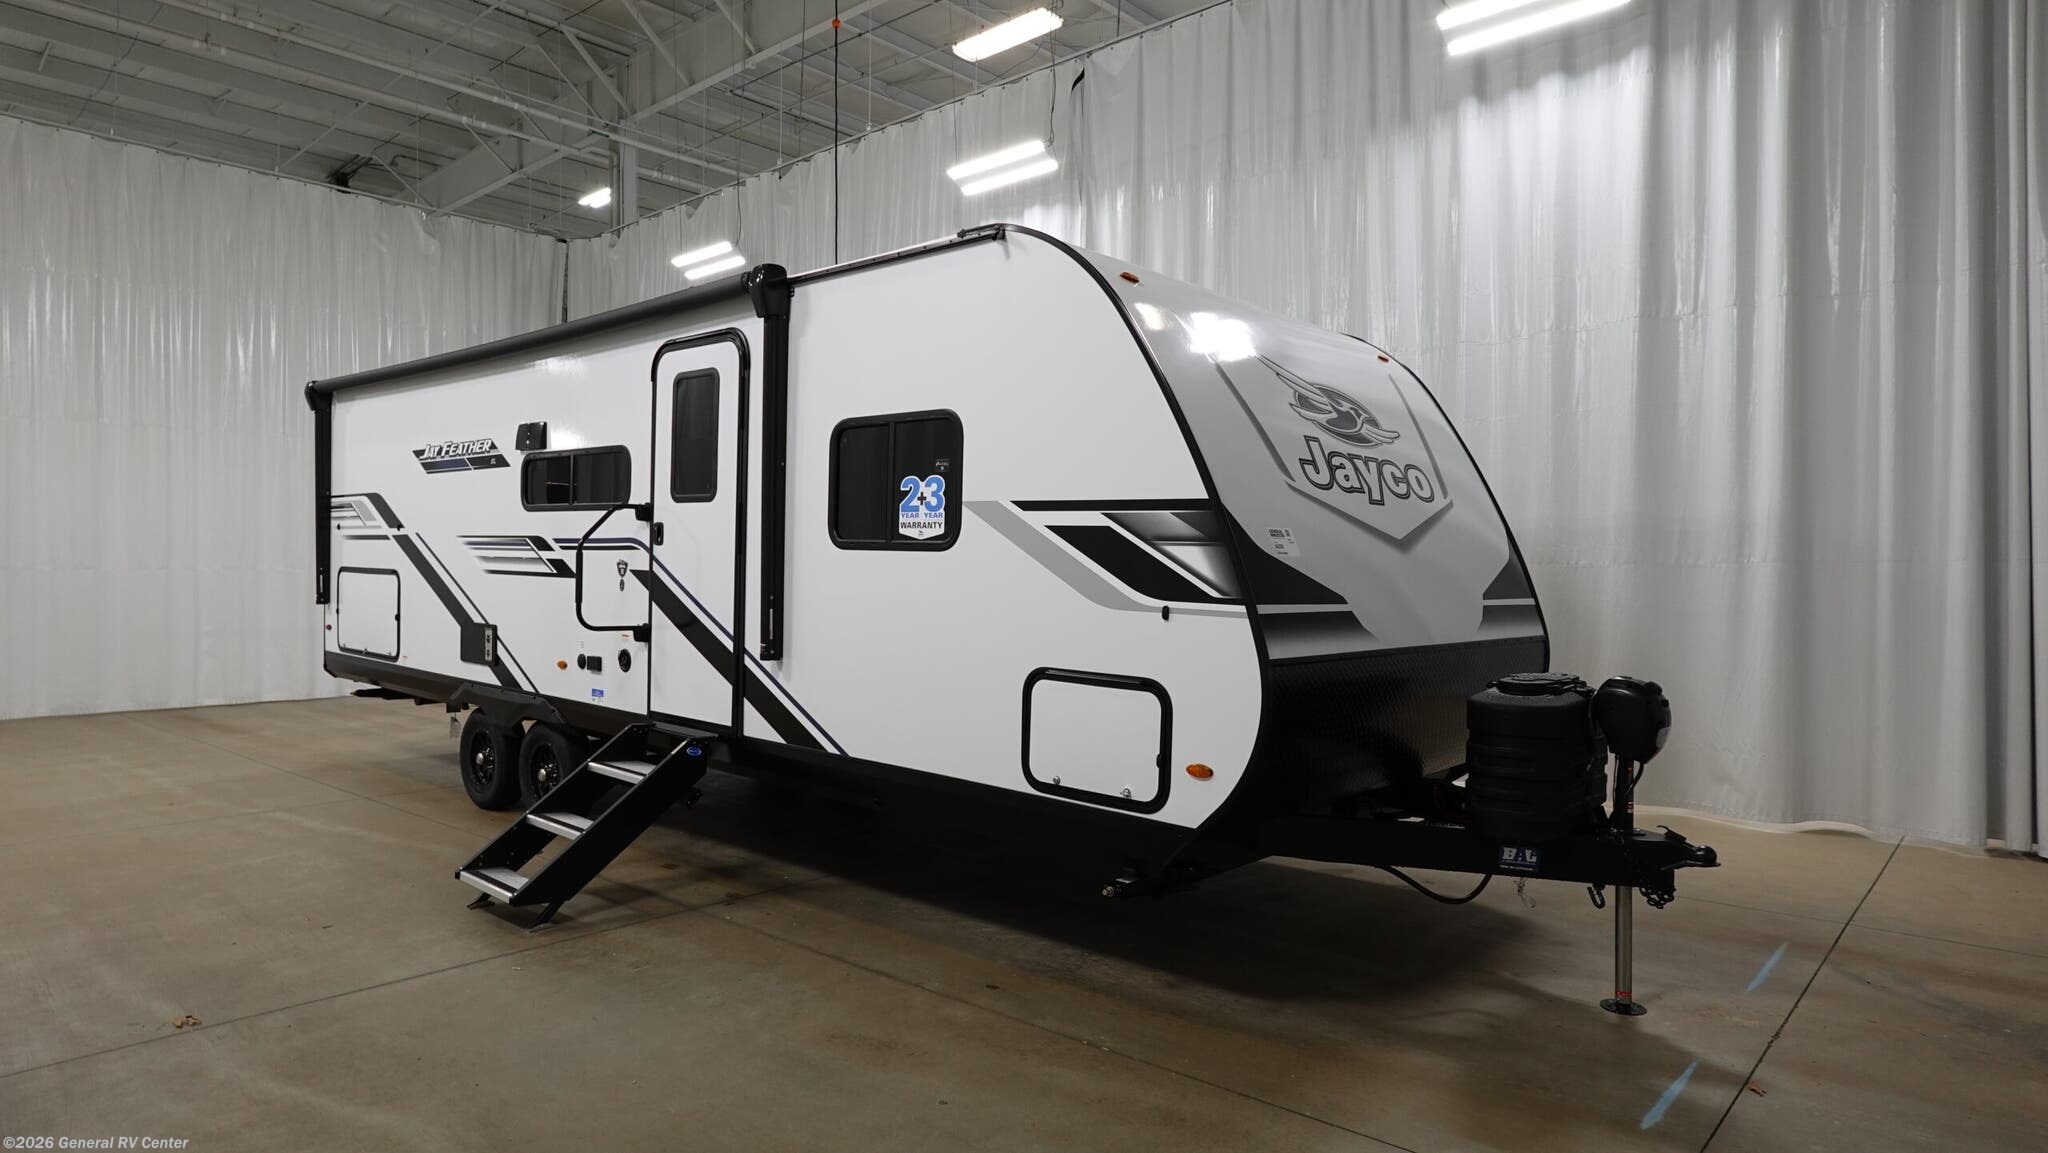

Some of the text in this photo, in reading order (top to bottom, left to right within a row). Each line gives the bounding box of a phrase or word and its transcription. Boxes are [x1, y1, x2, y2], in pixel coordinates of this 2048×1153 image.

[419, 440, 492, 459] JAY FEATHER
[1298, 435, 1435, 506] Jayco
[900, 521, 943, 529] WARRANTY
